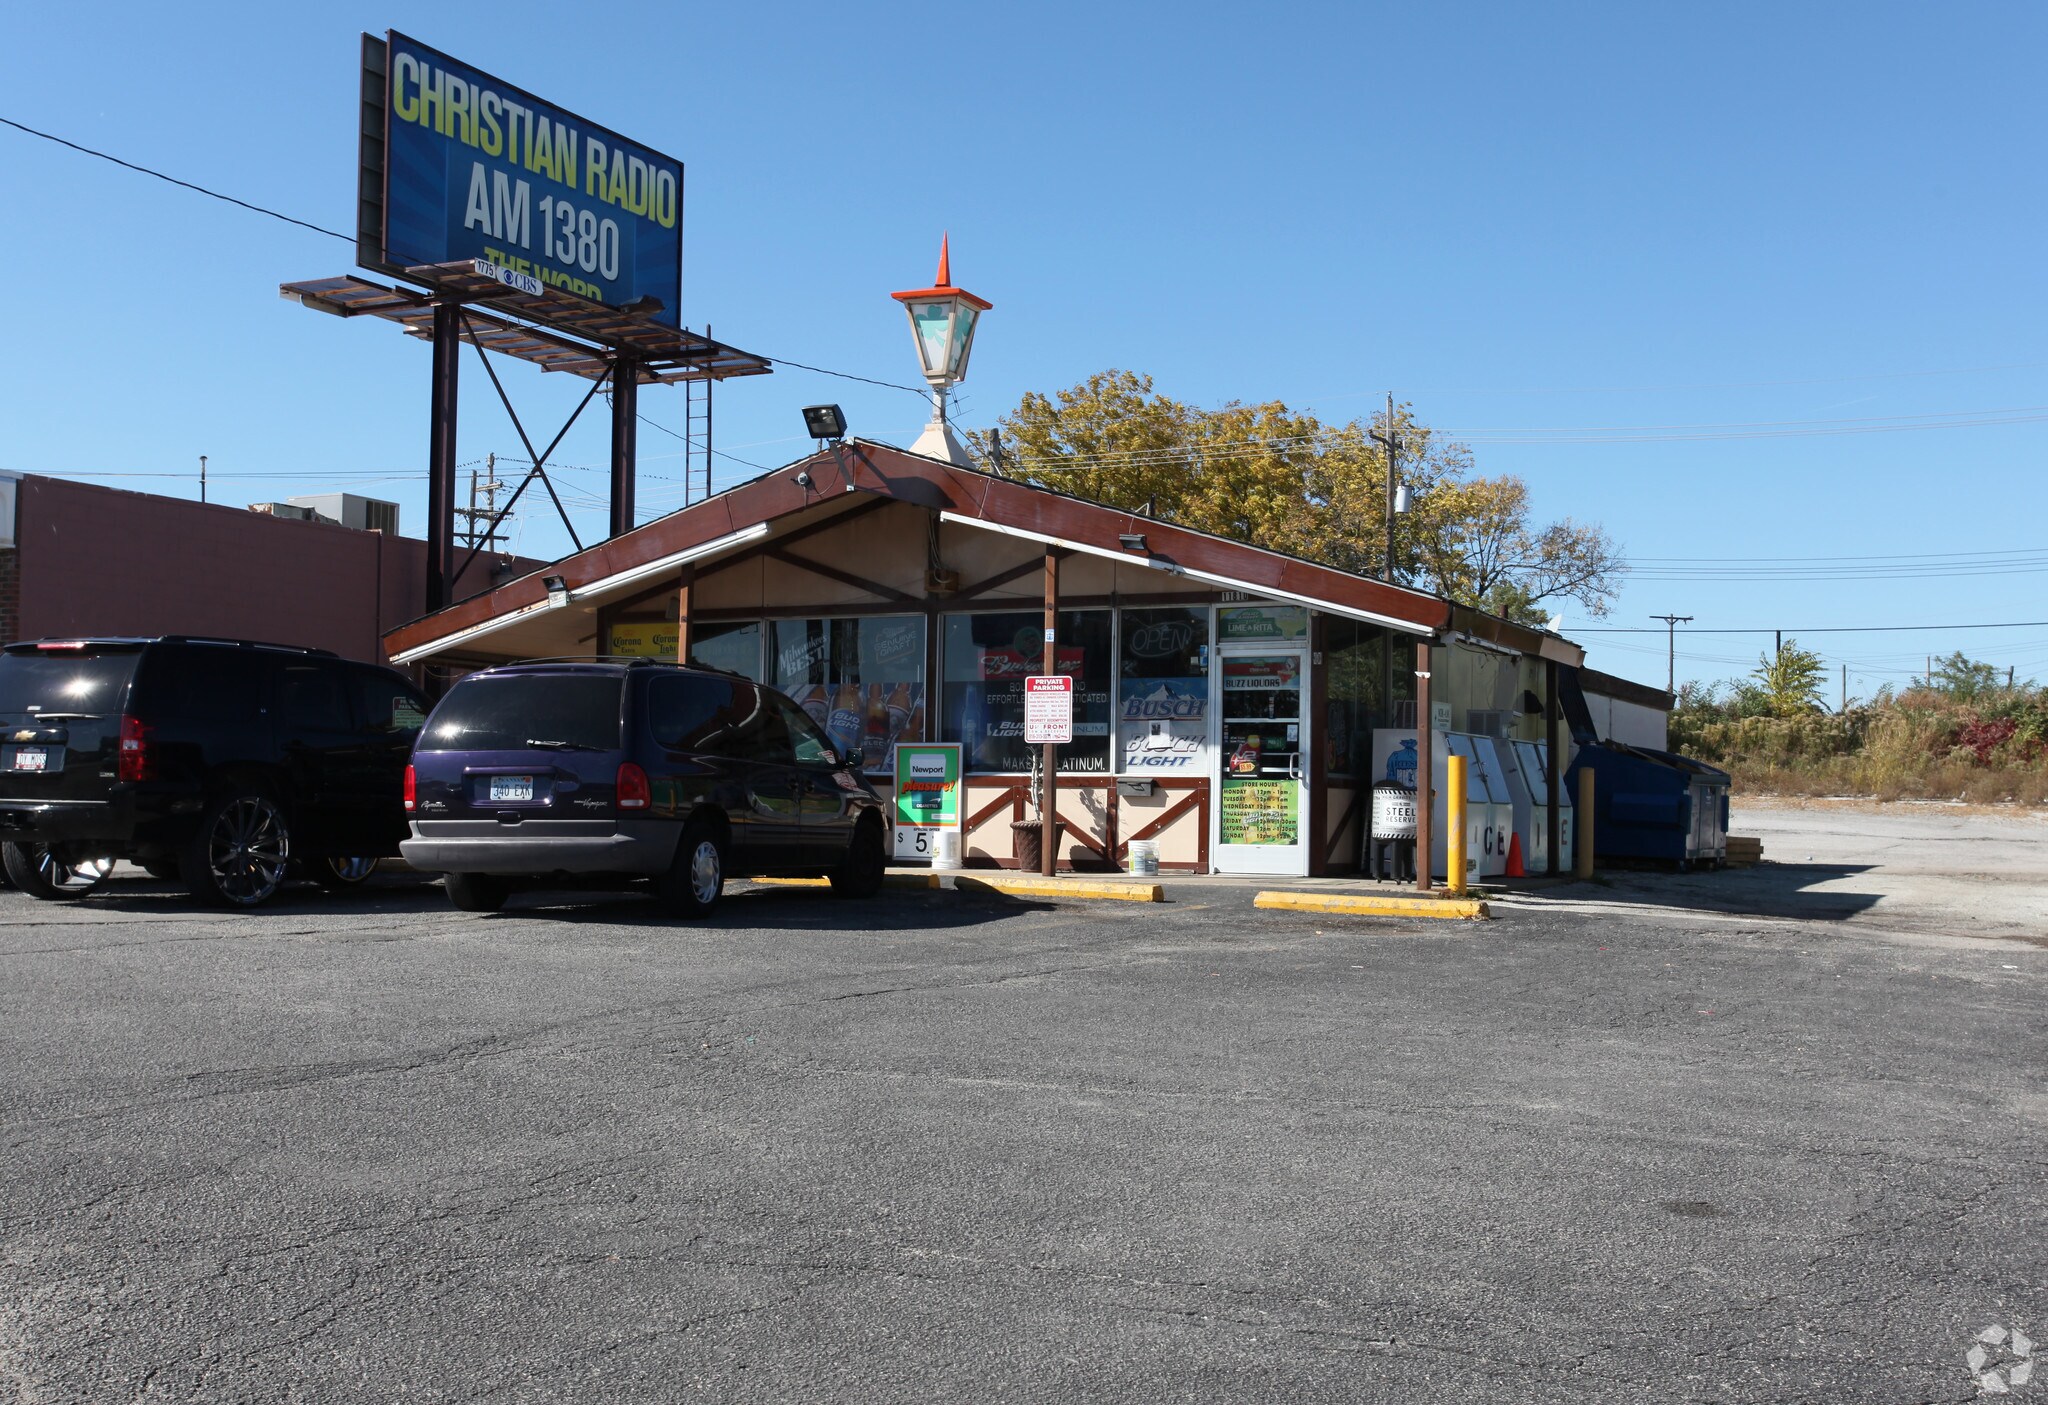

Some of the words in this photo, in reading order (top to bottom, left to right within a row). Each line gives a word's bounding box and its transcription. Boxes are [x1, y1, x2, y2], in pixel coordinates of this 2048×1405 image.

[394, 52, 577, 190] CHRISTIAN
[586, 136, 675, 228] RADIO
[464, 161, 531, 250] AM
[539, 195, 619, 281] 1380
[477, 261, 495, 277] 1775
[514, 273, 538, 294] CBS
[614, 637, 641, 647] Corona
[874, 631, 917, 651] GENUINE
[1132, 628, 1187, 651] OPEN
[660, 645, 676, 653] Light
[880, 640, 911, 656] DRAFT
[787, 646, 825, 678] BEST
[1010, 682, 1025, 691] BOL
[1226, 680, 1247, 688] BUZZ
[1248, 679, 1280, 688] LIQUORS
[987, 694, 1025, 704] EFFORTLE
[1125, 699, 1207, 719] BUSCH
[829, 718, 860, 730] LIGHT
[834, 712, 860, 724] BUD
[1127, 756, 1193, 766] LIGHT
[913, 766, 943, 774] Newport
[494, 785, 510, 797] 340
[515, 785, 531, 796] EXK
[902, 780, 955, 794] pleasure!
[1386, 808, 1416, 816] STEEL
[897, 832, 904, 844] $
[1475, 826, 1505, 856] ICE
